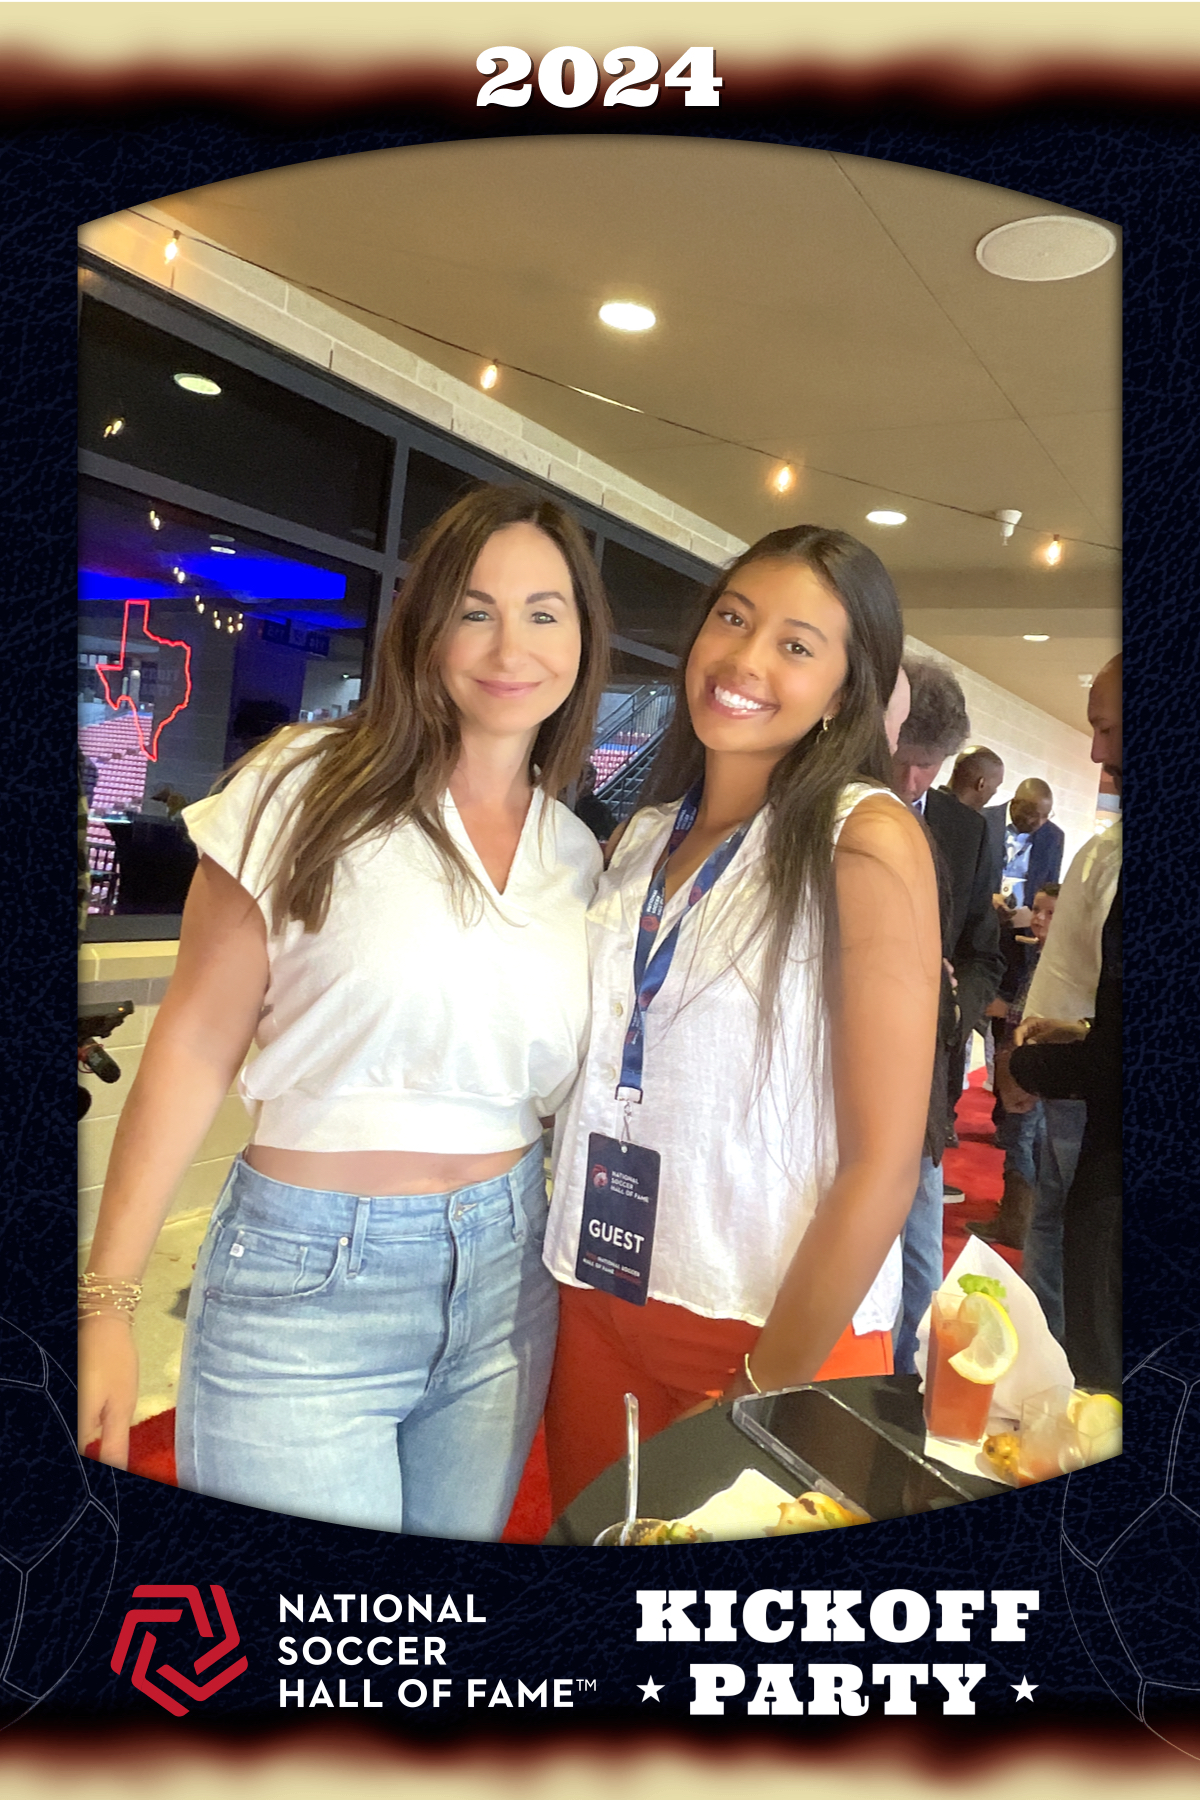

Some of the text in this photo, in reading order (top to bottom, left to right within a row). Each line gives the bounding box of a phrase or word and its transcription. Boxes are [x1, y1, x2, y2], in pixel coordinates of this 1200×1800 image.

[611, 1170, 639, 1185] NATIONAL
[611, 1177, 634, 1190] SOCCER
[610, 1185, 649, 1203] HALL OF FAME
[588, 1219, 645, 1254] GUEST
